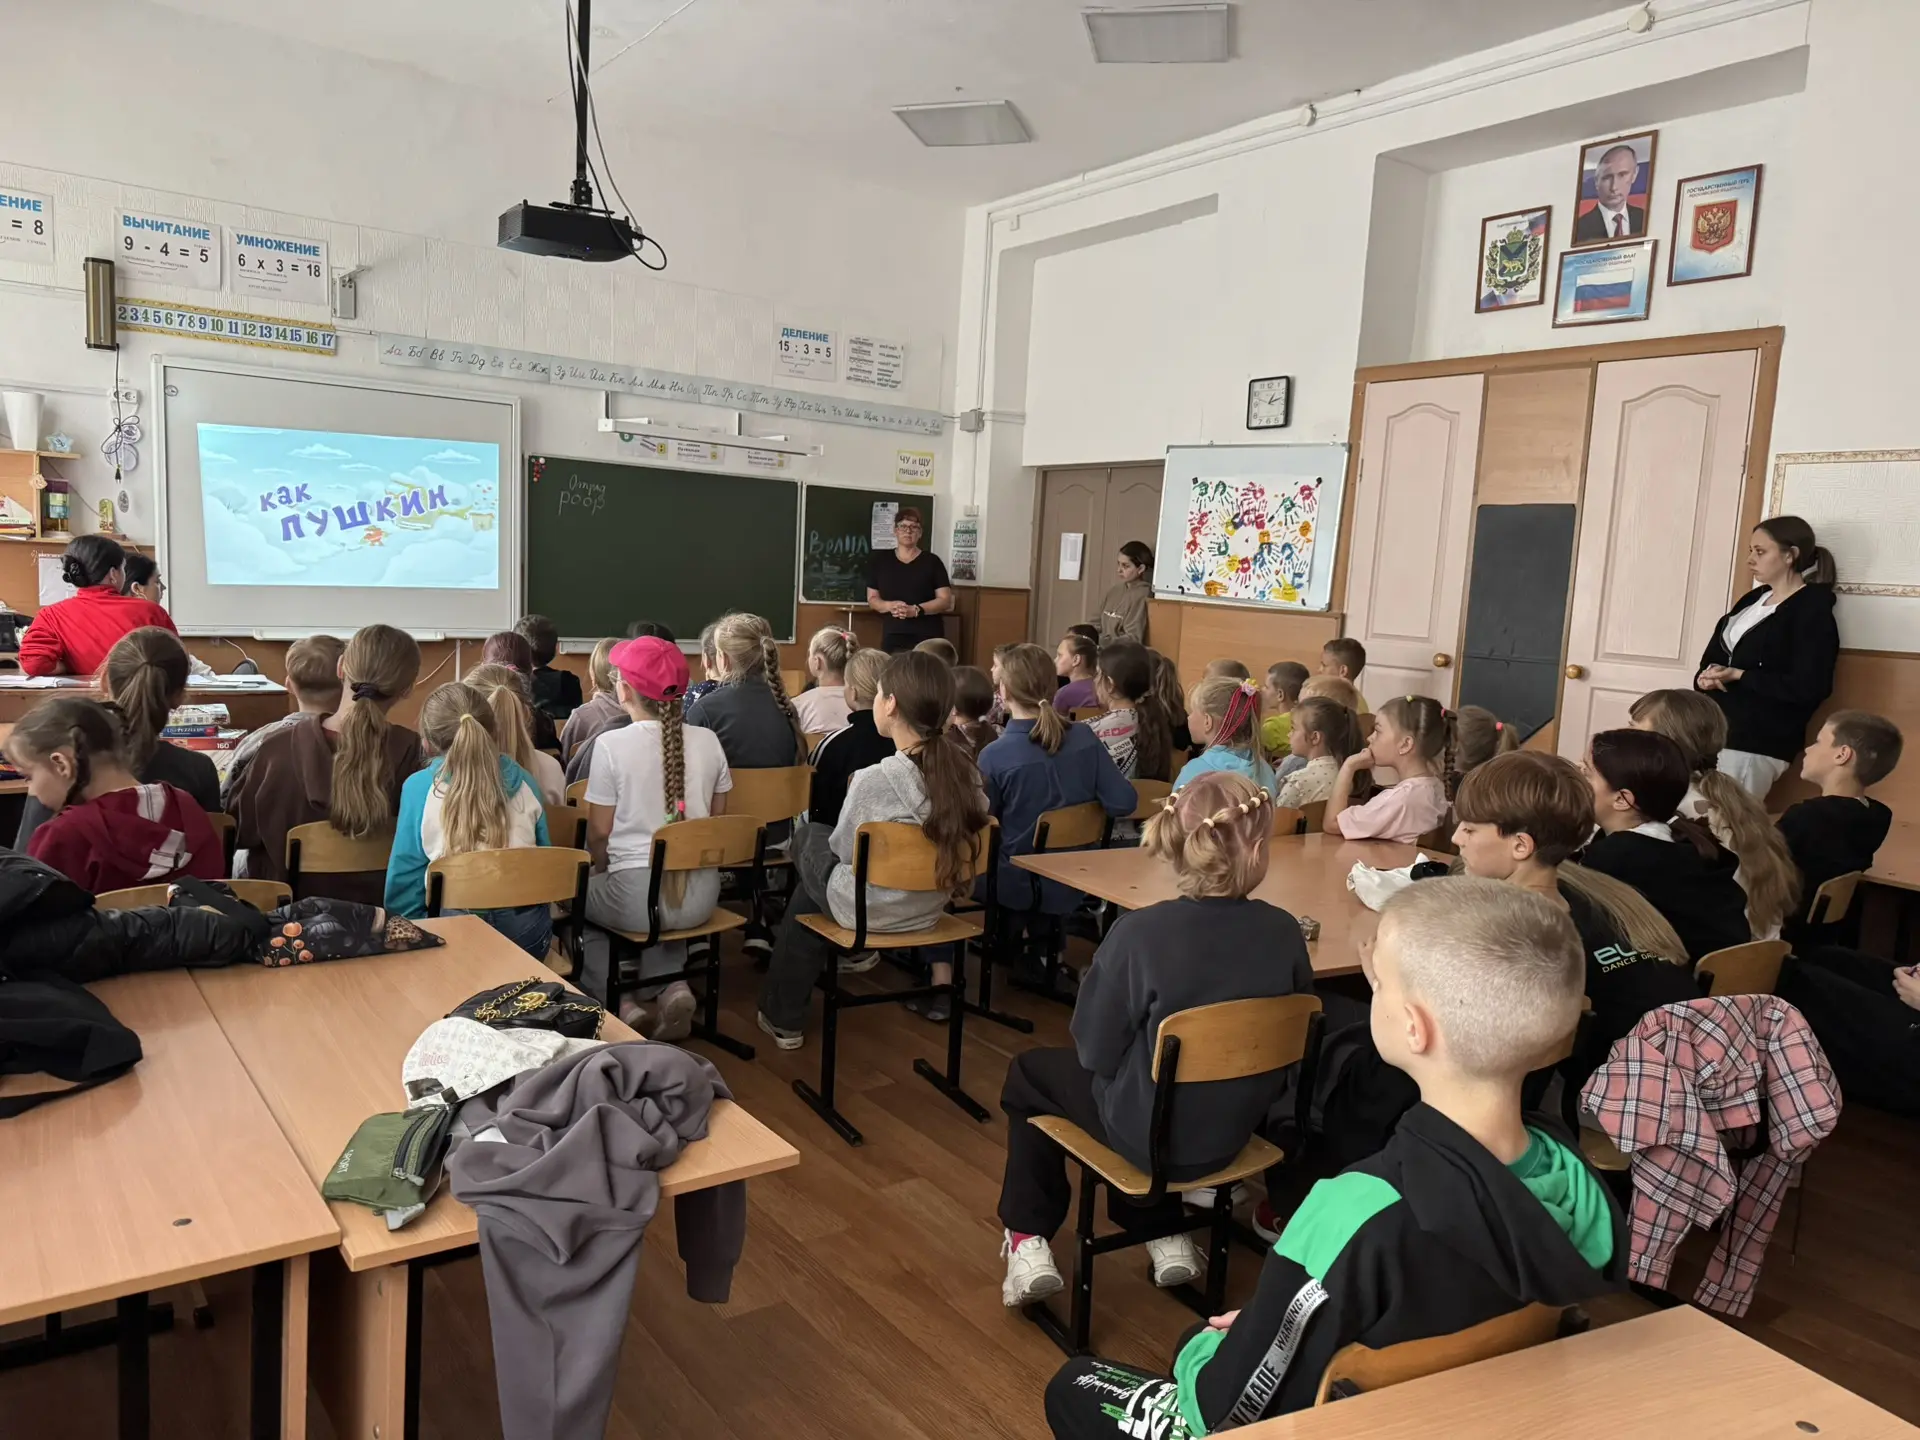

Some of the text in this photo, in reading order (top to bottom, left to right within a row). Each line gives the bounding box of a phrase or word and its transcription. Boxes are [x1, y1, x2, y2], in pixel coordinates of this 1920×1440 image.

[34, 219, 44, 235] 8
[123, 215, 210, 240] ВЫЧИТАНИЕ
[124, 236, 133, 250] 9
[160, 242, 170, 256] 4
[200, 248, 208, 263] 5
[236, 233, 320, 256] УМНОЖЕНИЕ
[238, 253, 246, 267] 6
[276, 259, 283, 272] 3
[306, 264, 321, 278] 18
[118, 306, 334, 347] 2 3 4 5 6 7 8 9 10 11 12 13 14 15 16 17
[781, 327, 829, 343] ДЕЛЕНИЕ
[779, 340, 790, 352] 15
[804, 344, 809, 355] 3
[825, 347, 831, 358] 5
[899, 467, 919, 477] пиши
[900, 455, 911, 465] ЧУ
[918, 457, 931, 467] ЩУ
[280, 484, 449, 542] ПУШКИН
[1601, 956, 1637, 973] DANCE
[1274, 1298, 1304, 1351] WARNING
